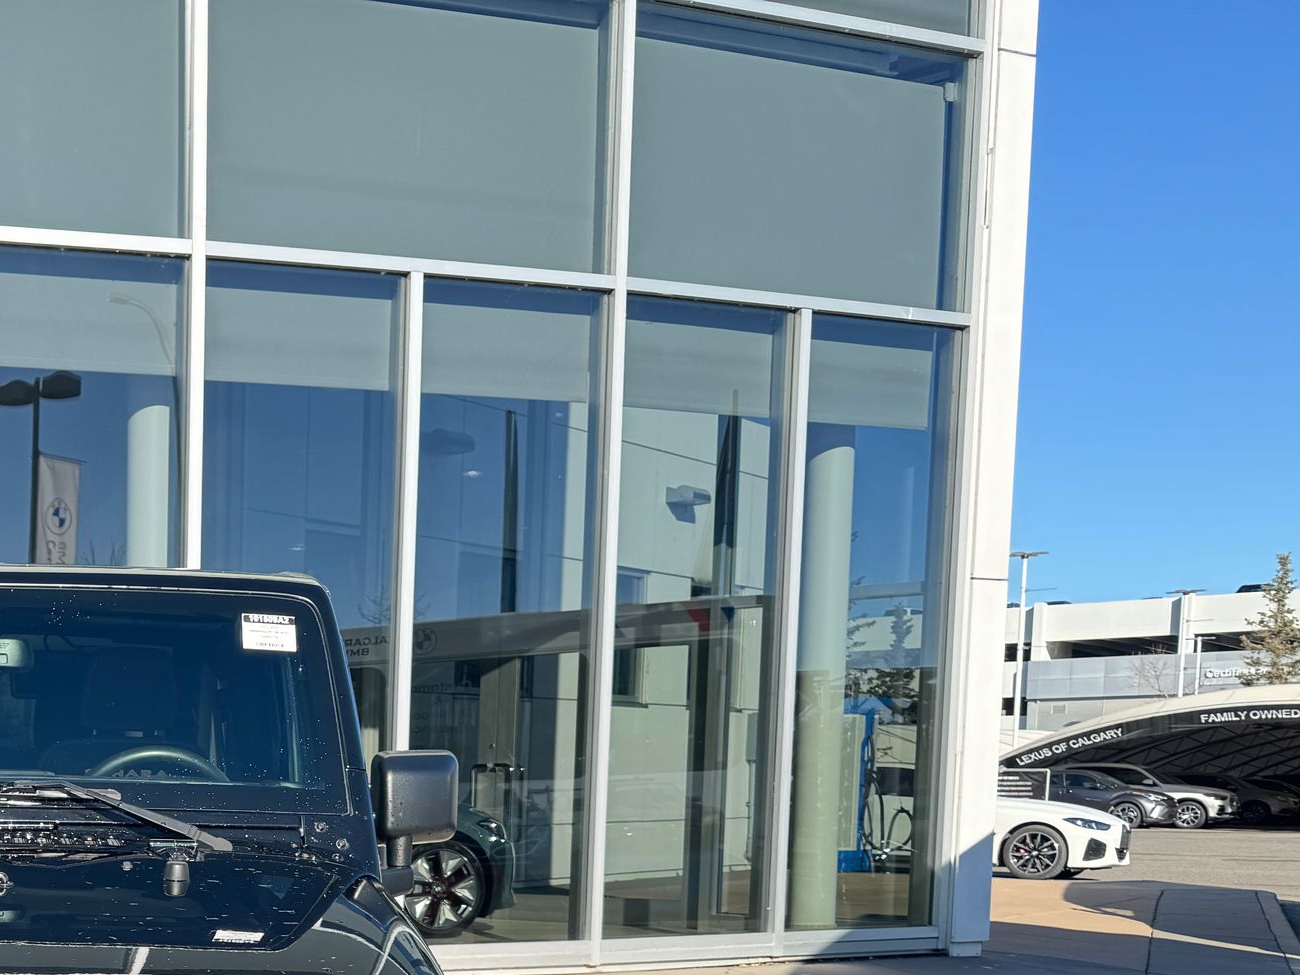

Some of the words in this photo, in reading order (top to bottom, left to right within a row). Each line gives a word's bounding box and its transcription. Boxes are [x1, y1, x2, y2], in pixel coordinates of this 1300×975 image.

[1200, 711, 1247, 723] FAMILY
[1249, 709, 1300, 720] OWNED
[1016, 747, 1052, 766] LEXUS
[1052, 742, 1067, 754] OF
[1069, 728, 1122, 748] CALGARY
